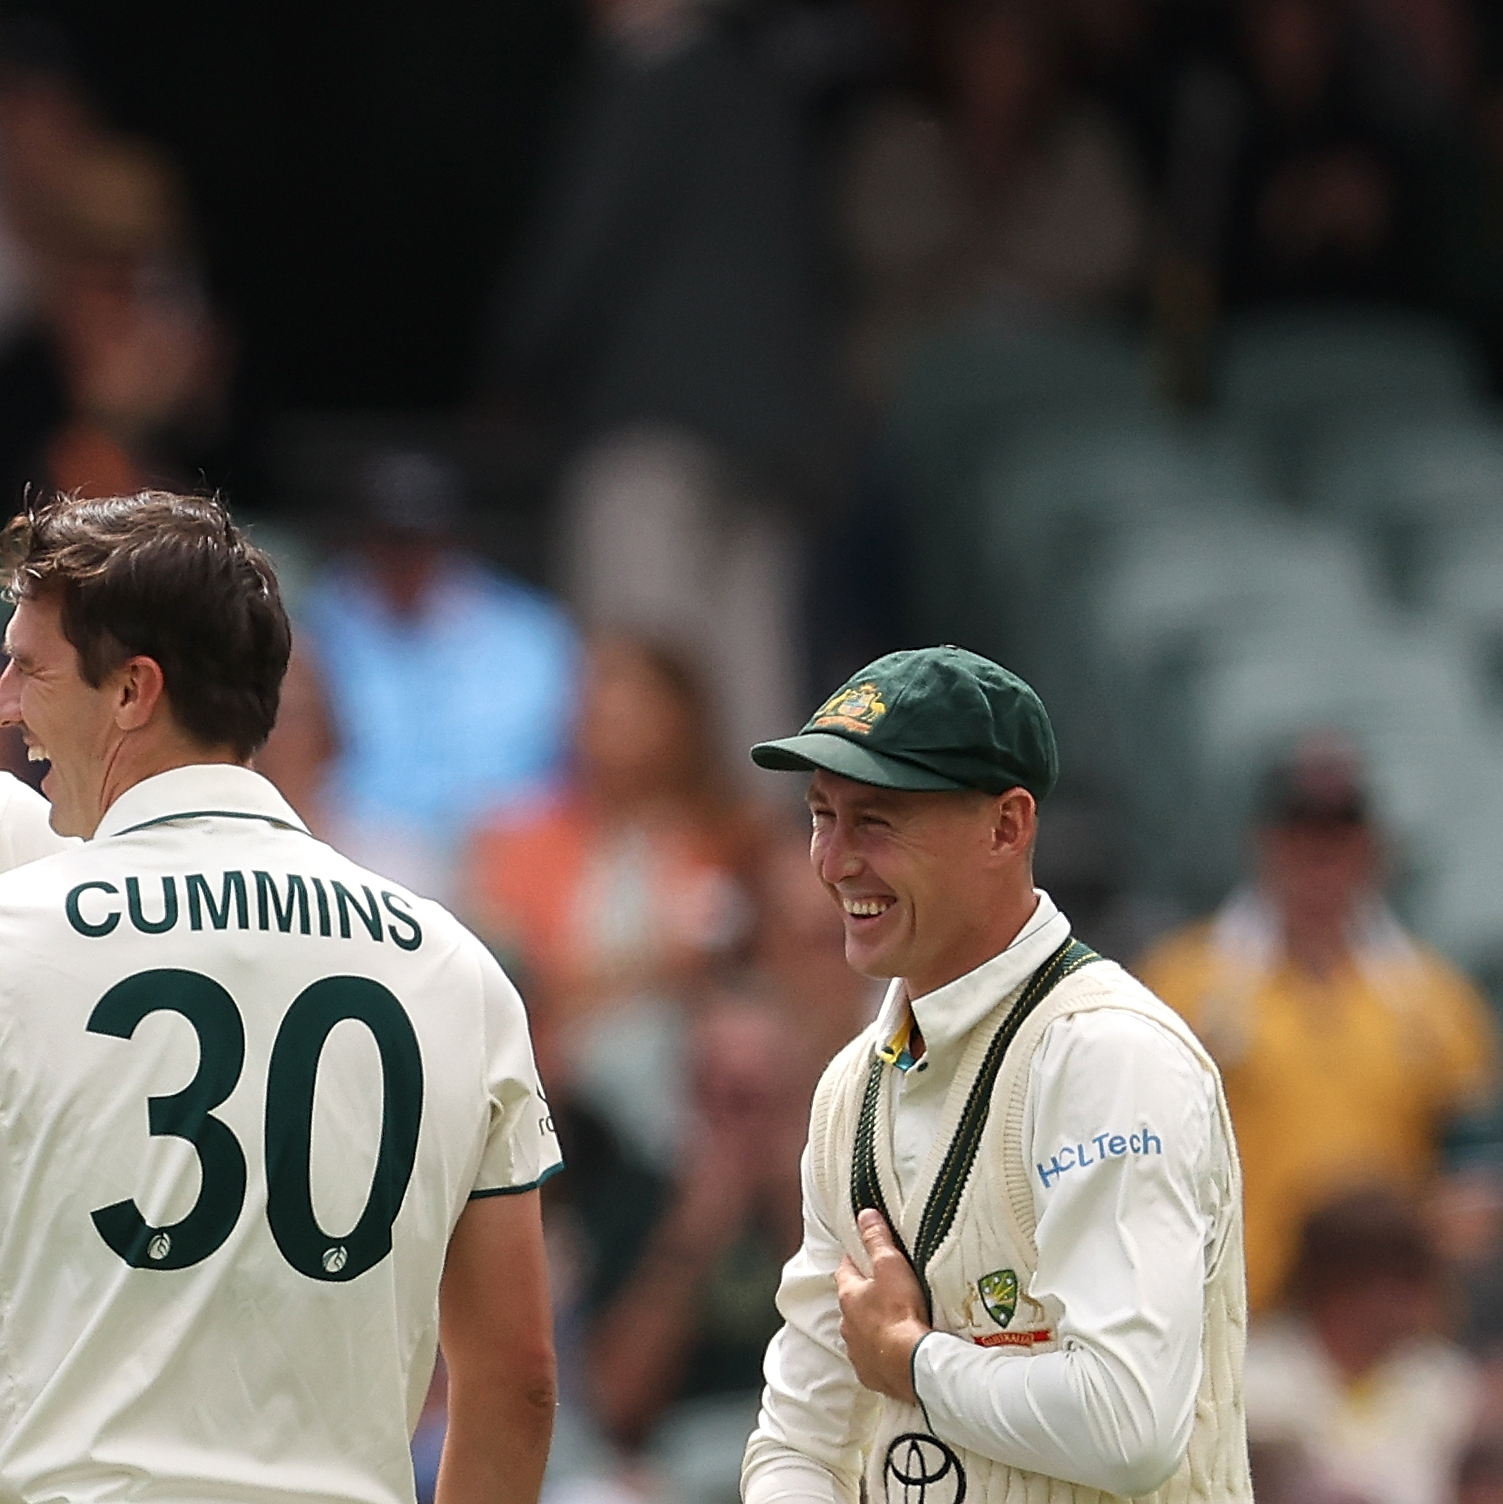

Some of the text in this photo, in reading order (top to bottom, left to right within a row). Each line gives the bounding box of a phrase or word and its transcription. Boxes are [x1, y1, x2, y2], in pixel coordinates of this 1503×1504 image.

[65, 870, 423, 952] CUMMINS
[86, 968, 424, 1283] 30
[1037, 1117, 1163, 1189] HCLTech
